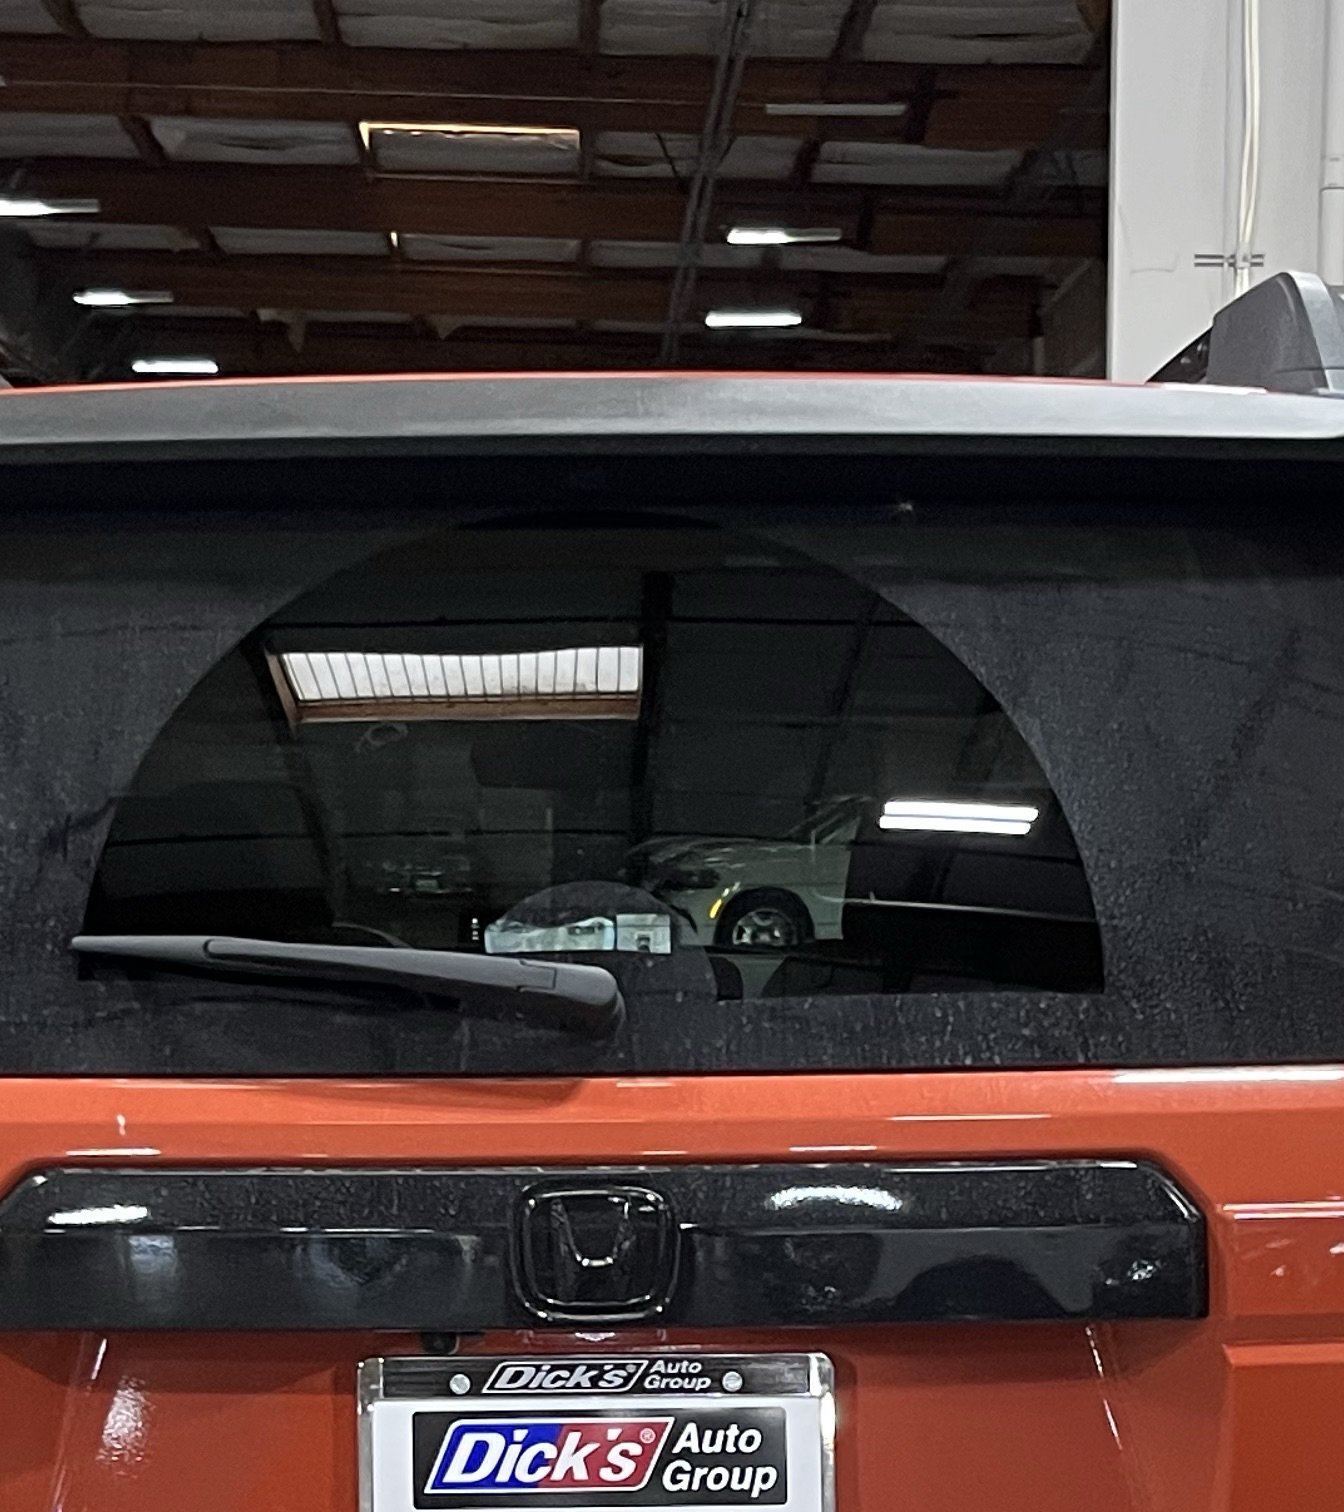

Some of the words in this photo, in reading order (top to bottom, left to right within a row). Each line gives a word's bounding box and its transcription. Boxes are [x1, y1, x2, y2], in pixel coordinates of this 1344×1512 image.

[494, 1365, 630, 1389] Dick's
[650, 1360, 702, 1374] Auto
[644, 1375, 712, 1391] Group
[442, 1429, 644, 1484] Dick's
[671, 1423, 762, 1454] Auto
[662, 1460, 778, 1498] Group
